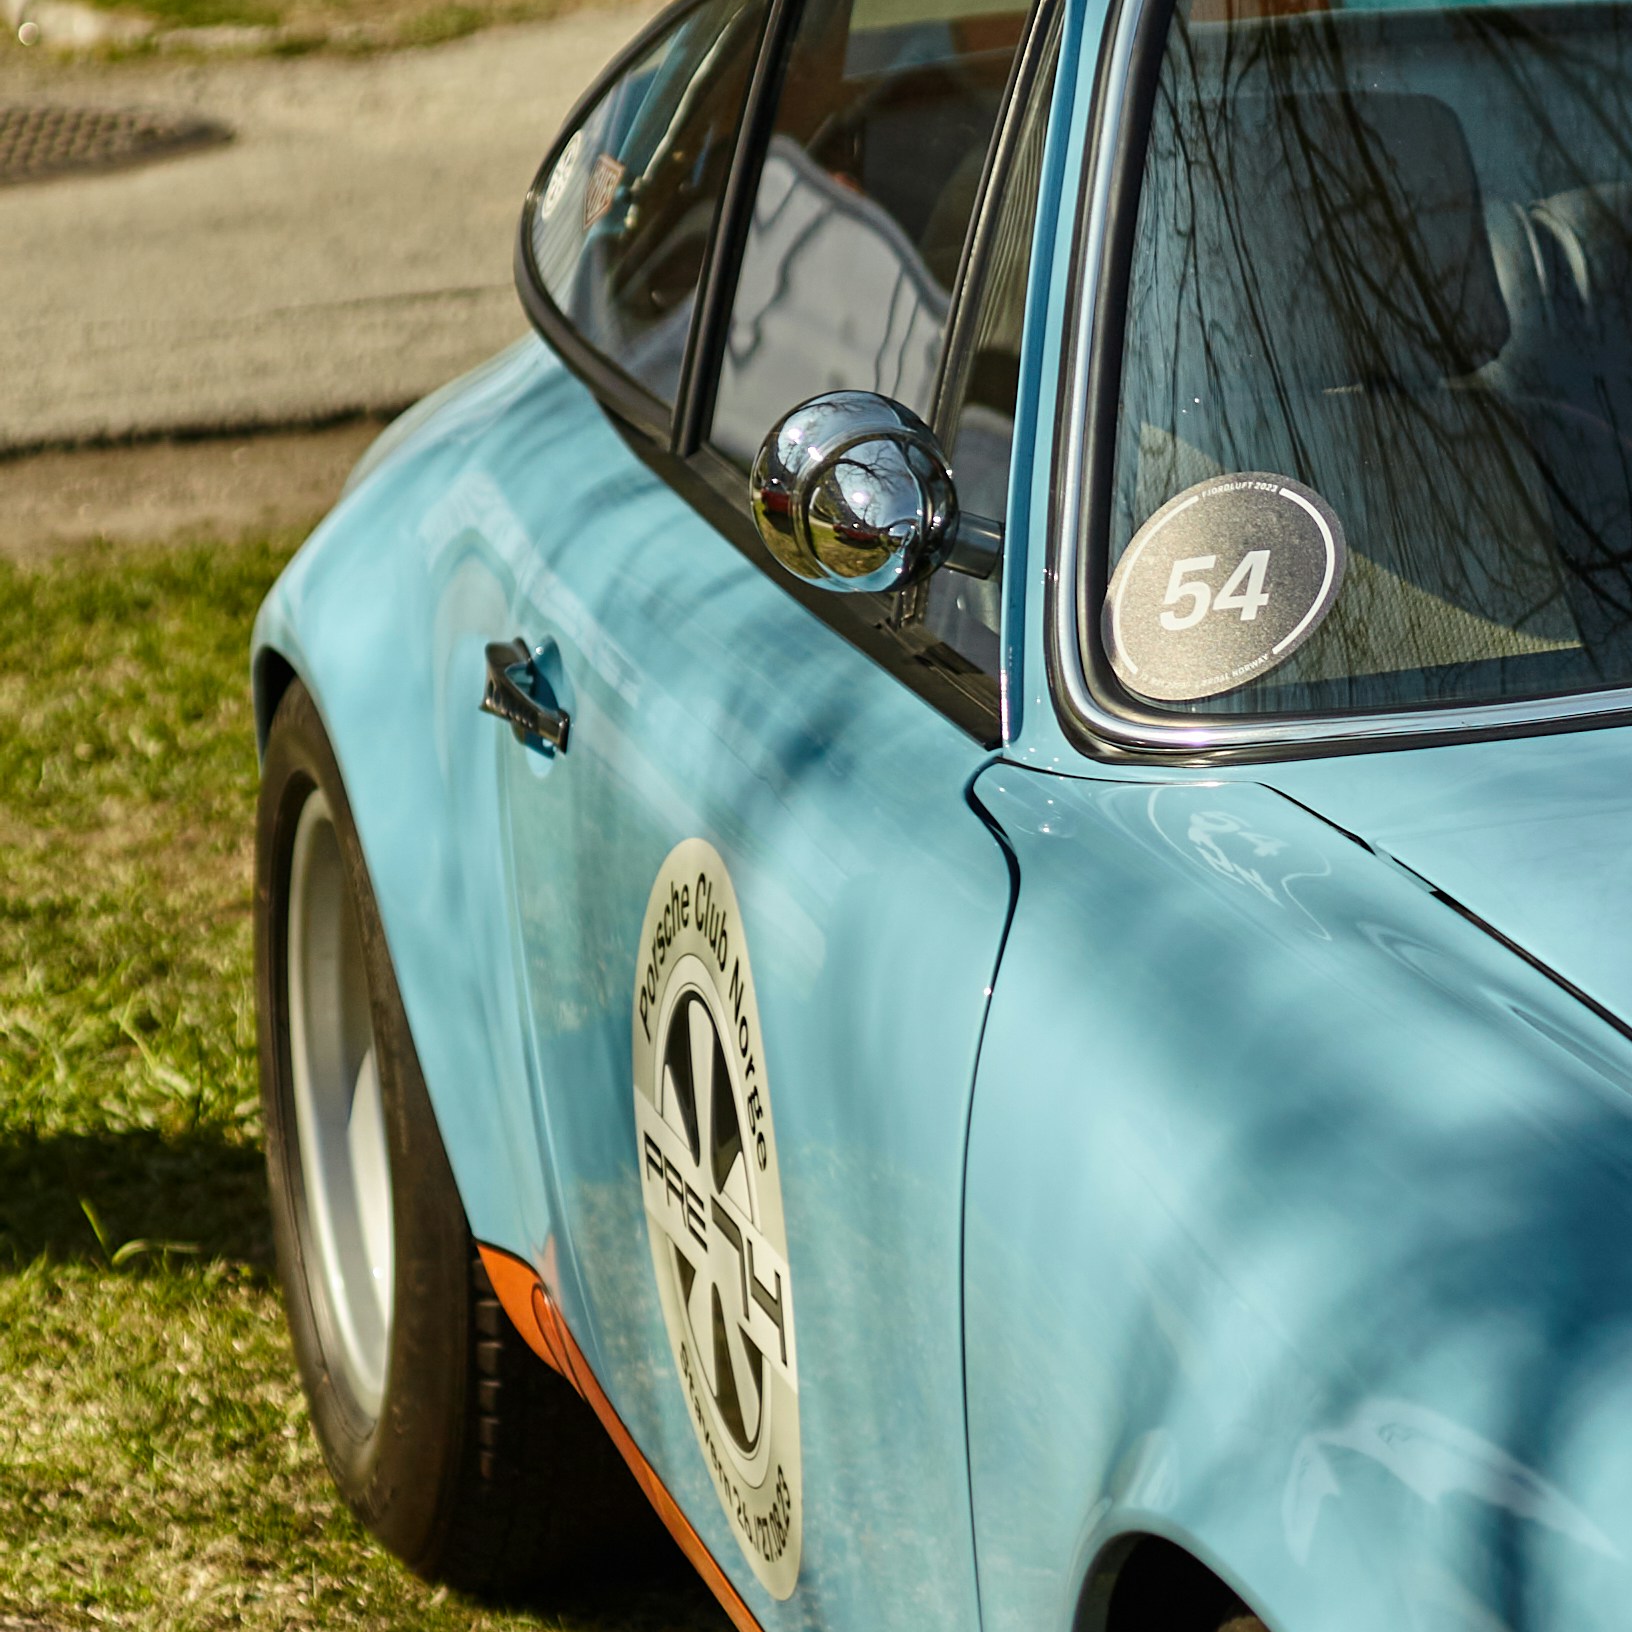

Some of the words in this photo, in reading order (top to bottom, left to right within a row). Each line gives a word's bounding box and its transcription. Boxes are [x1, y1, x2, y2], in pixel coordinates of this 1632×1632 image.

[1160, 549, 1271, 632] 54
[1231, 652, 1270, 677] NORWAY
[639, 880, 690, 1044] Porsche
[694, 871, 729, 973] Club
[728, 955, 768, 1173] Norge
[643, 1129, 709, 1255] PRE
[679, 1340, 733, 1508] Stavern
